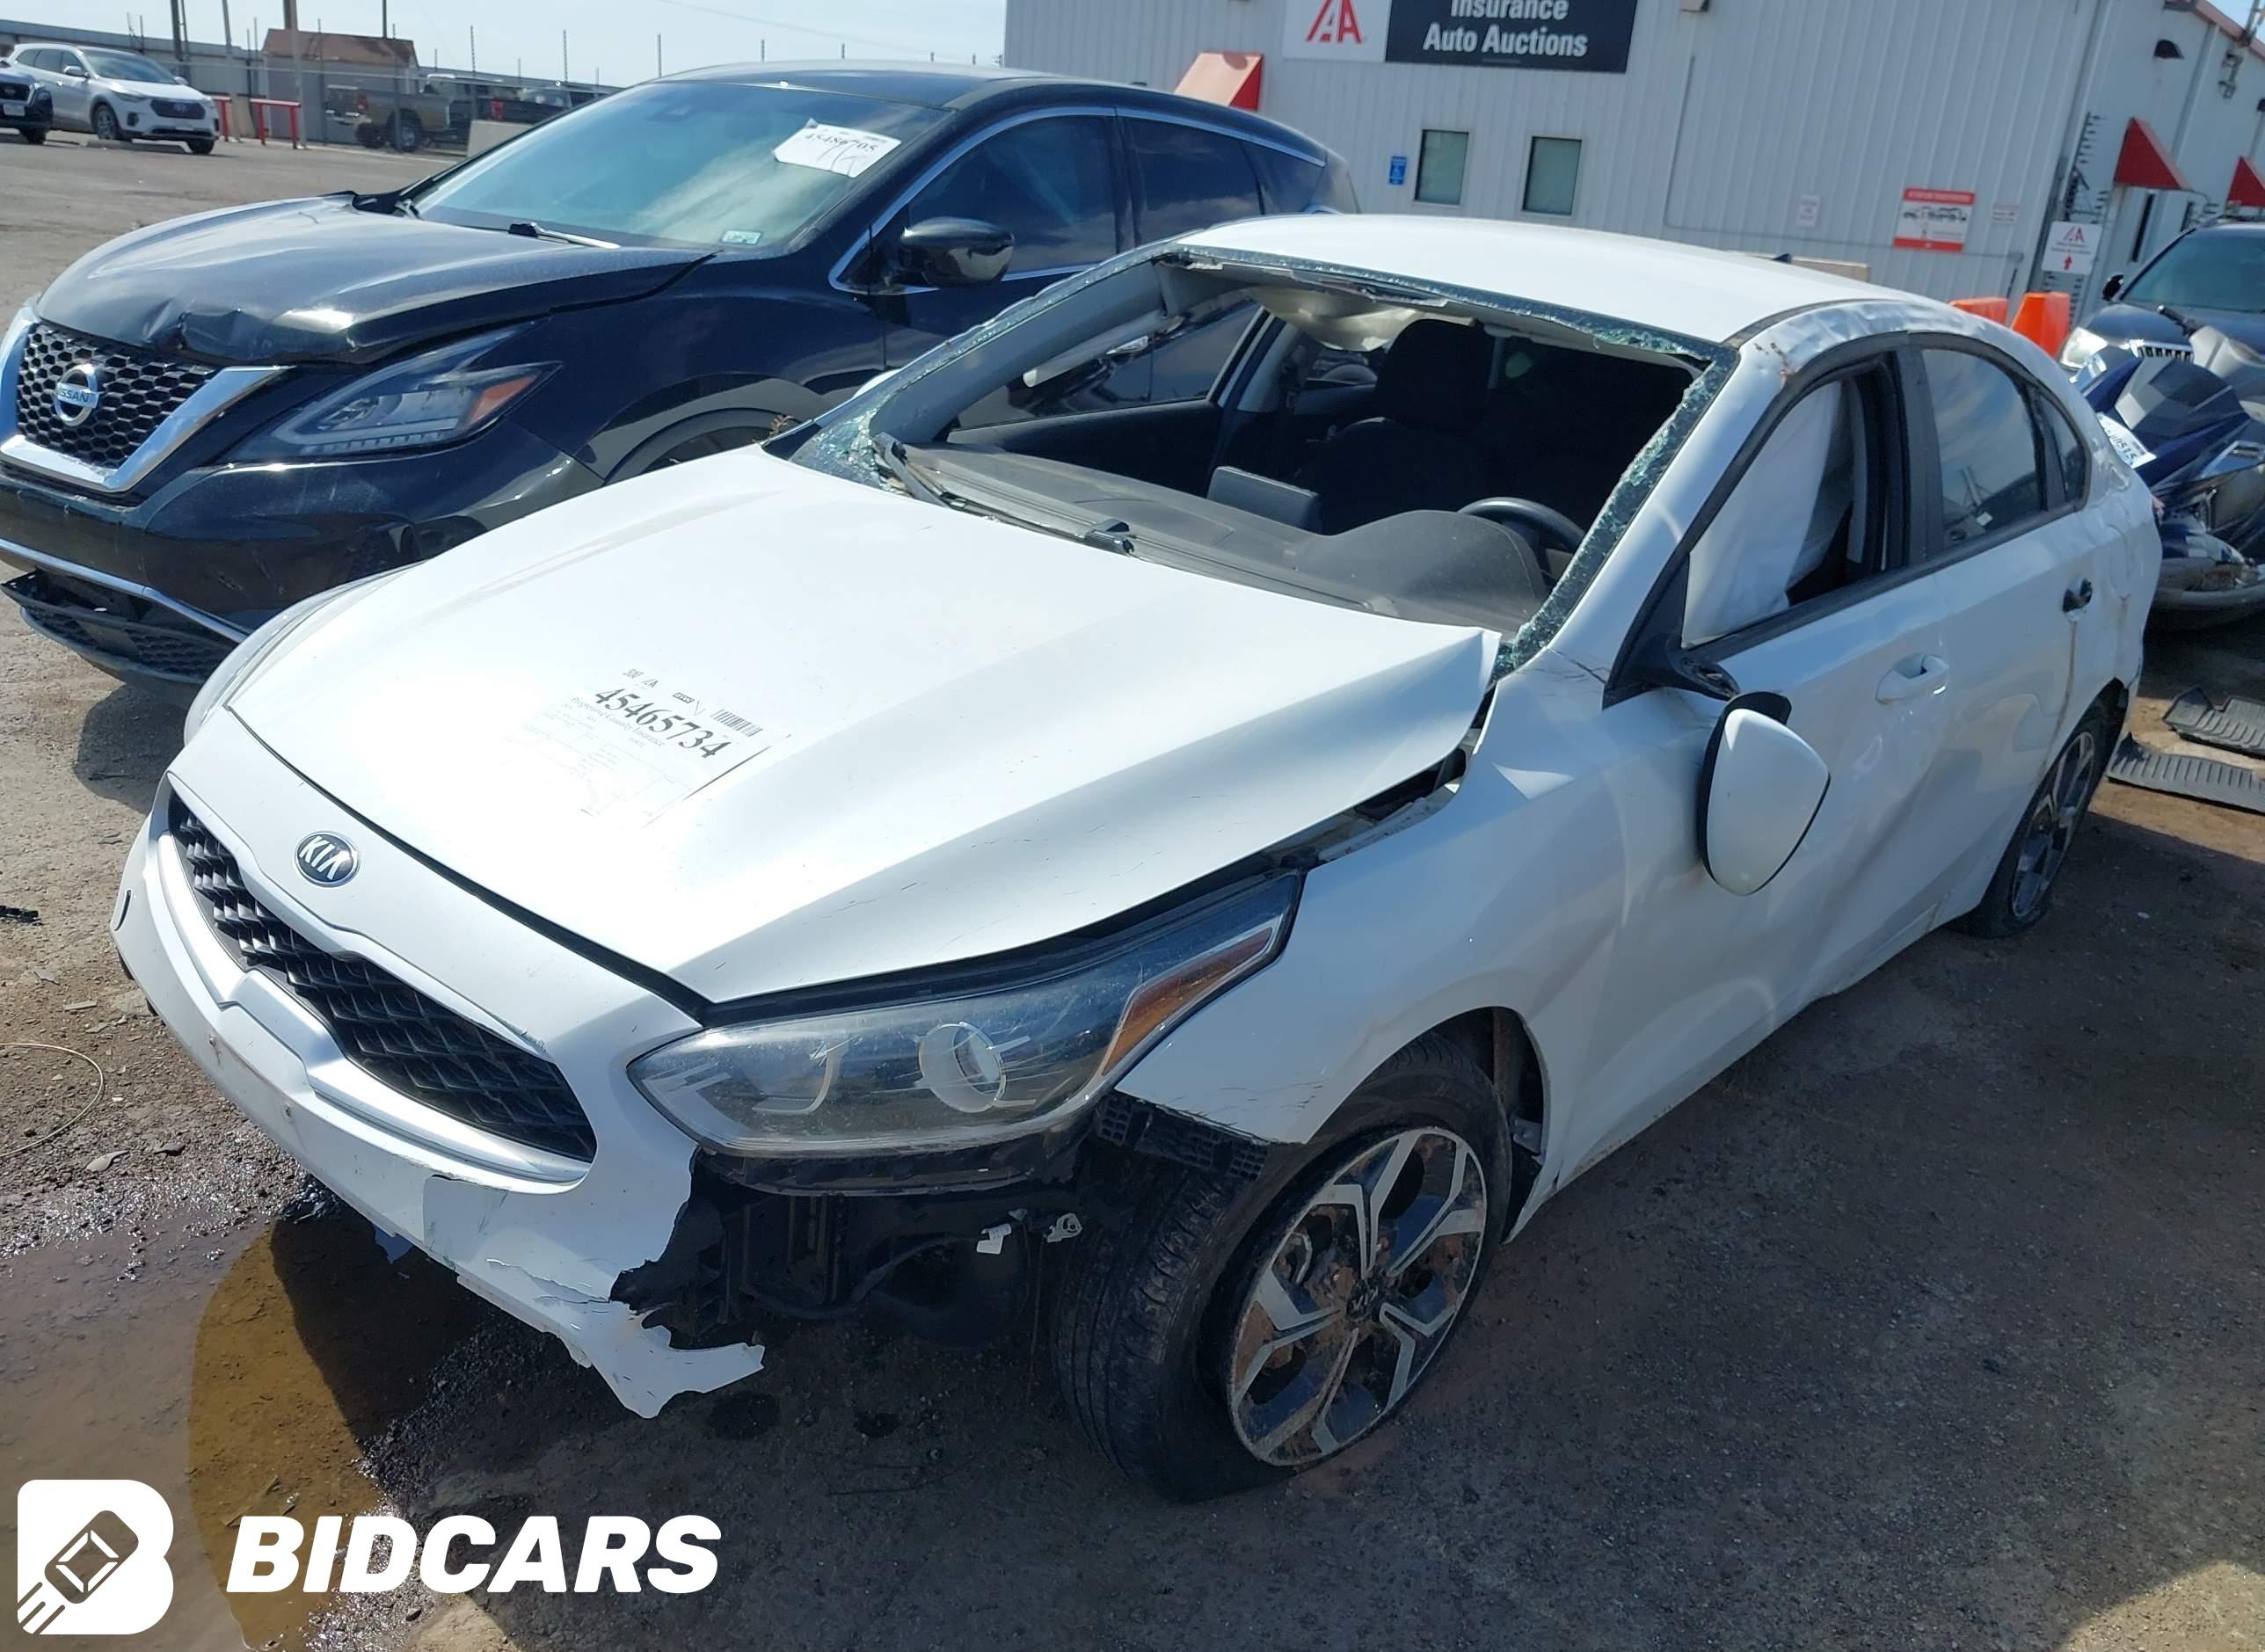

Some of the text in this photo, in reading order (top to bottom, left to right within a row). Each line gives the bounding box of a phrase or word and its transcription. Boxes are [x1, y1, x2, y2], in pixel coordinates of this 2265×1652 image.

[1423, 23, 1588, 57] Auto Auctions
[57, 387, 89, 402] SSAN
[594, 688, 732, 759] 45465734
[299, 836, 352, 880] KIA
